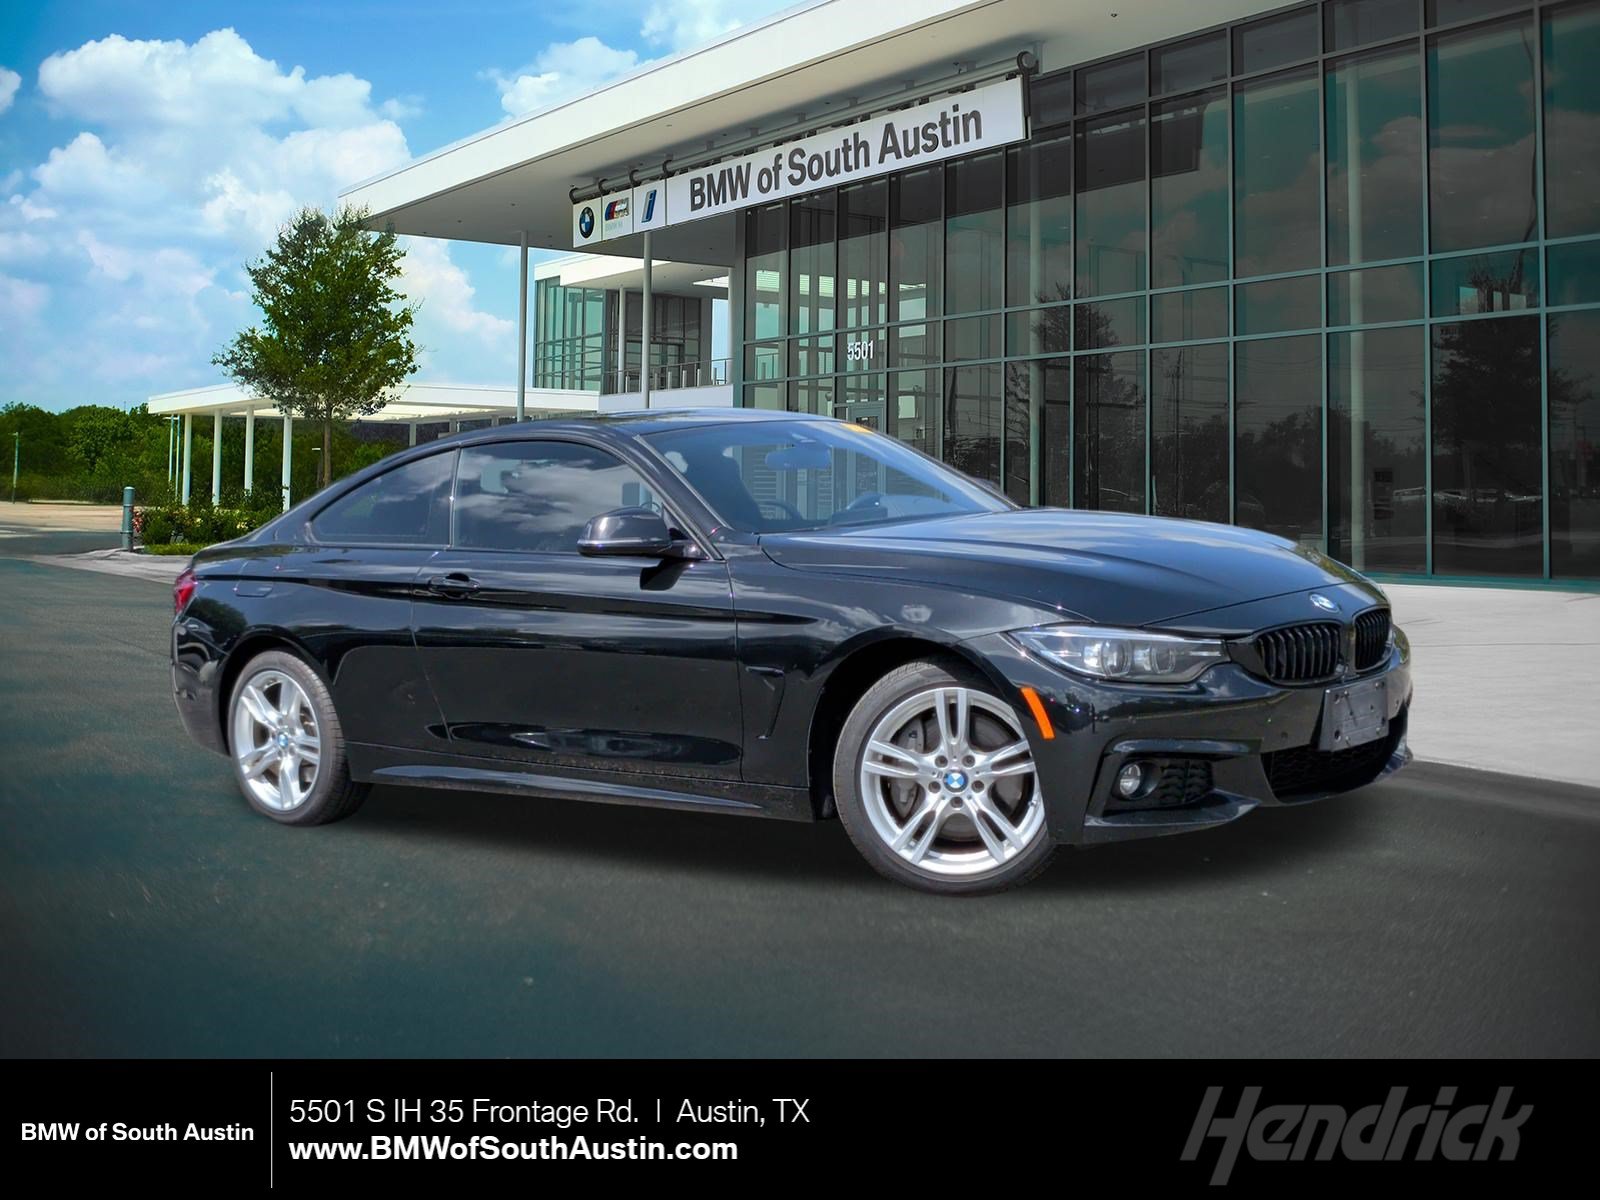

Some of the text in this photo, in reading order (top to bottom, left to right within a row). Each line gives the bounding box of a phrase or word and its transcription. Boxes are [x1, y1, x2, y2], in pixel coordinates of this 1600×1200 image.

[690, 162, 752, 212] BMW
[757, 153, 783, 194] of
[787, 132, 871, 187] South
[878, 103, 983, 165] Austin
[847, 340, 874, 361] 5501
